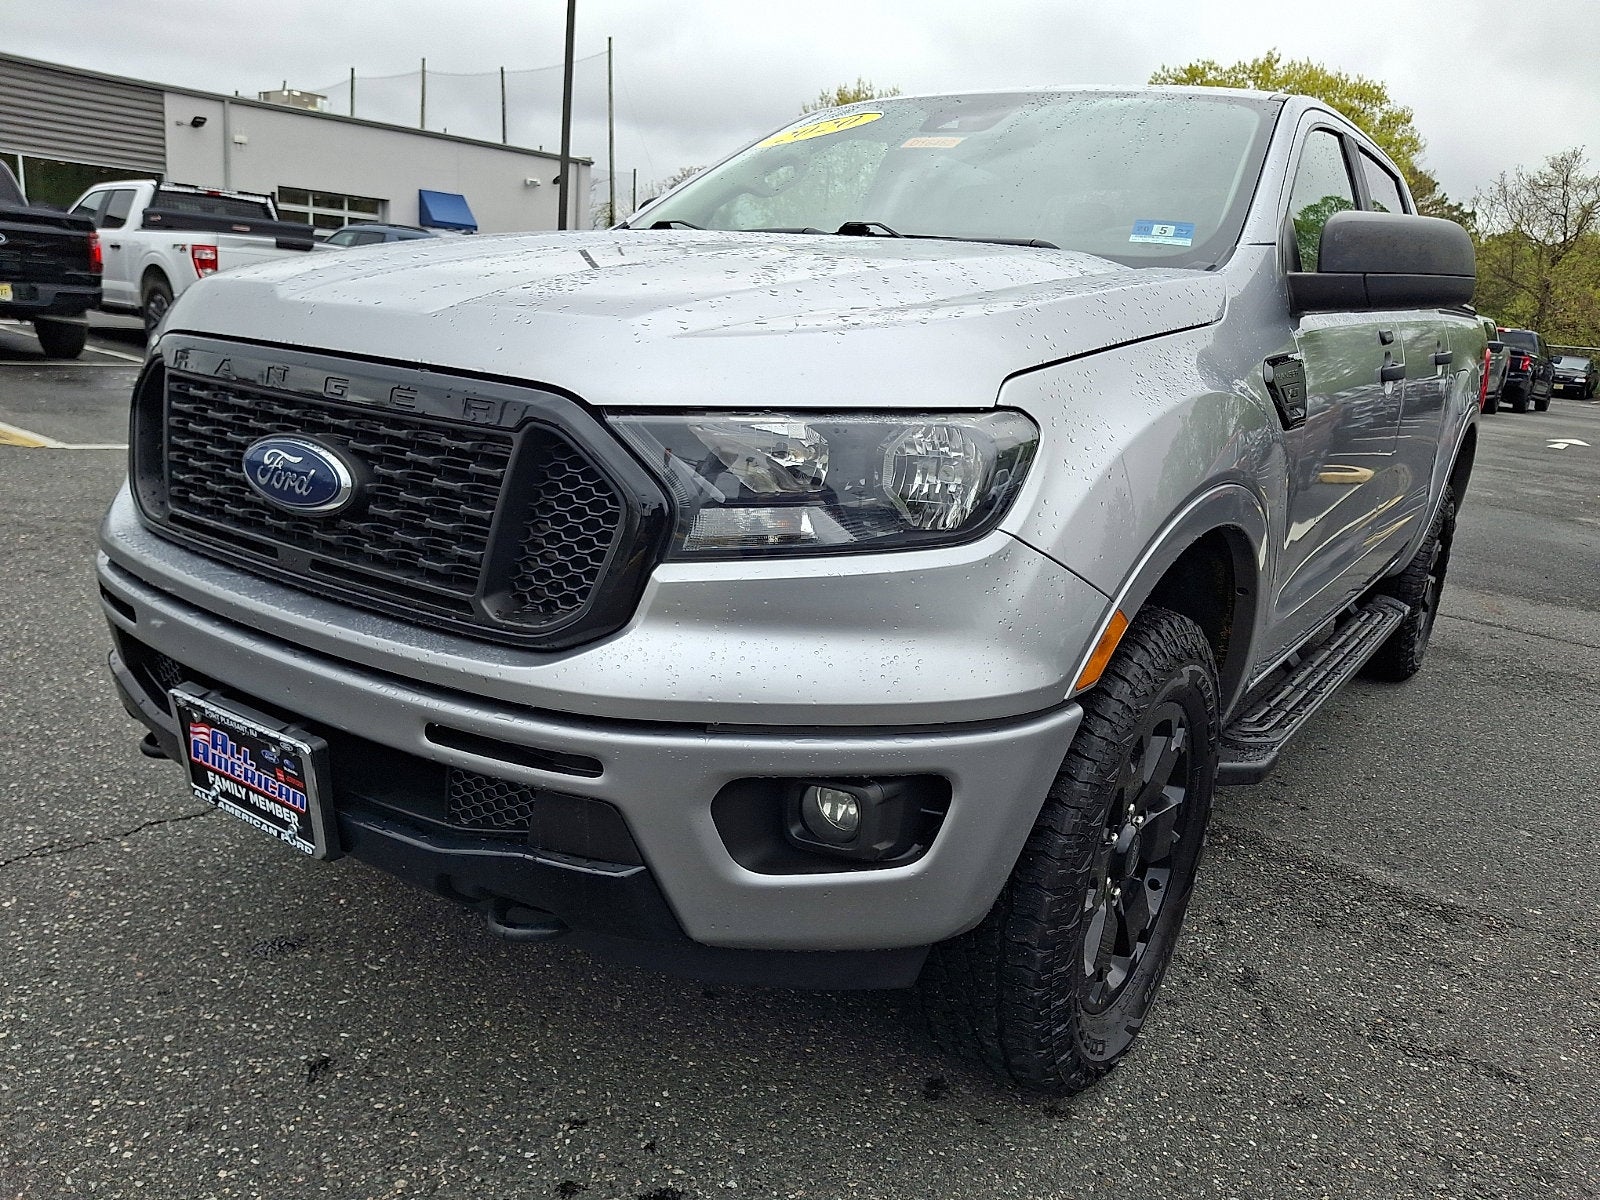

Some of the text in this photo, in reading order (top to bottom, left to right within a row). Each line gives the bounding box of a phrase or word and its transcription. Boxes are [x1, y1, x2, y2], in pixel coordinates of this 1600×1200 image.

[1158, 226, 1168, 235] 5
[173, 348, 498, 425] RANGER
[257, 448, 317, 496] Ford
[207, 770, 246, 801] FAMILY
[249, 790, 300, 827] MEMBER
[217, 802, 278, 838] AMERICAN
